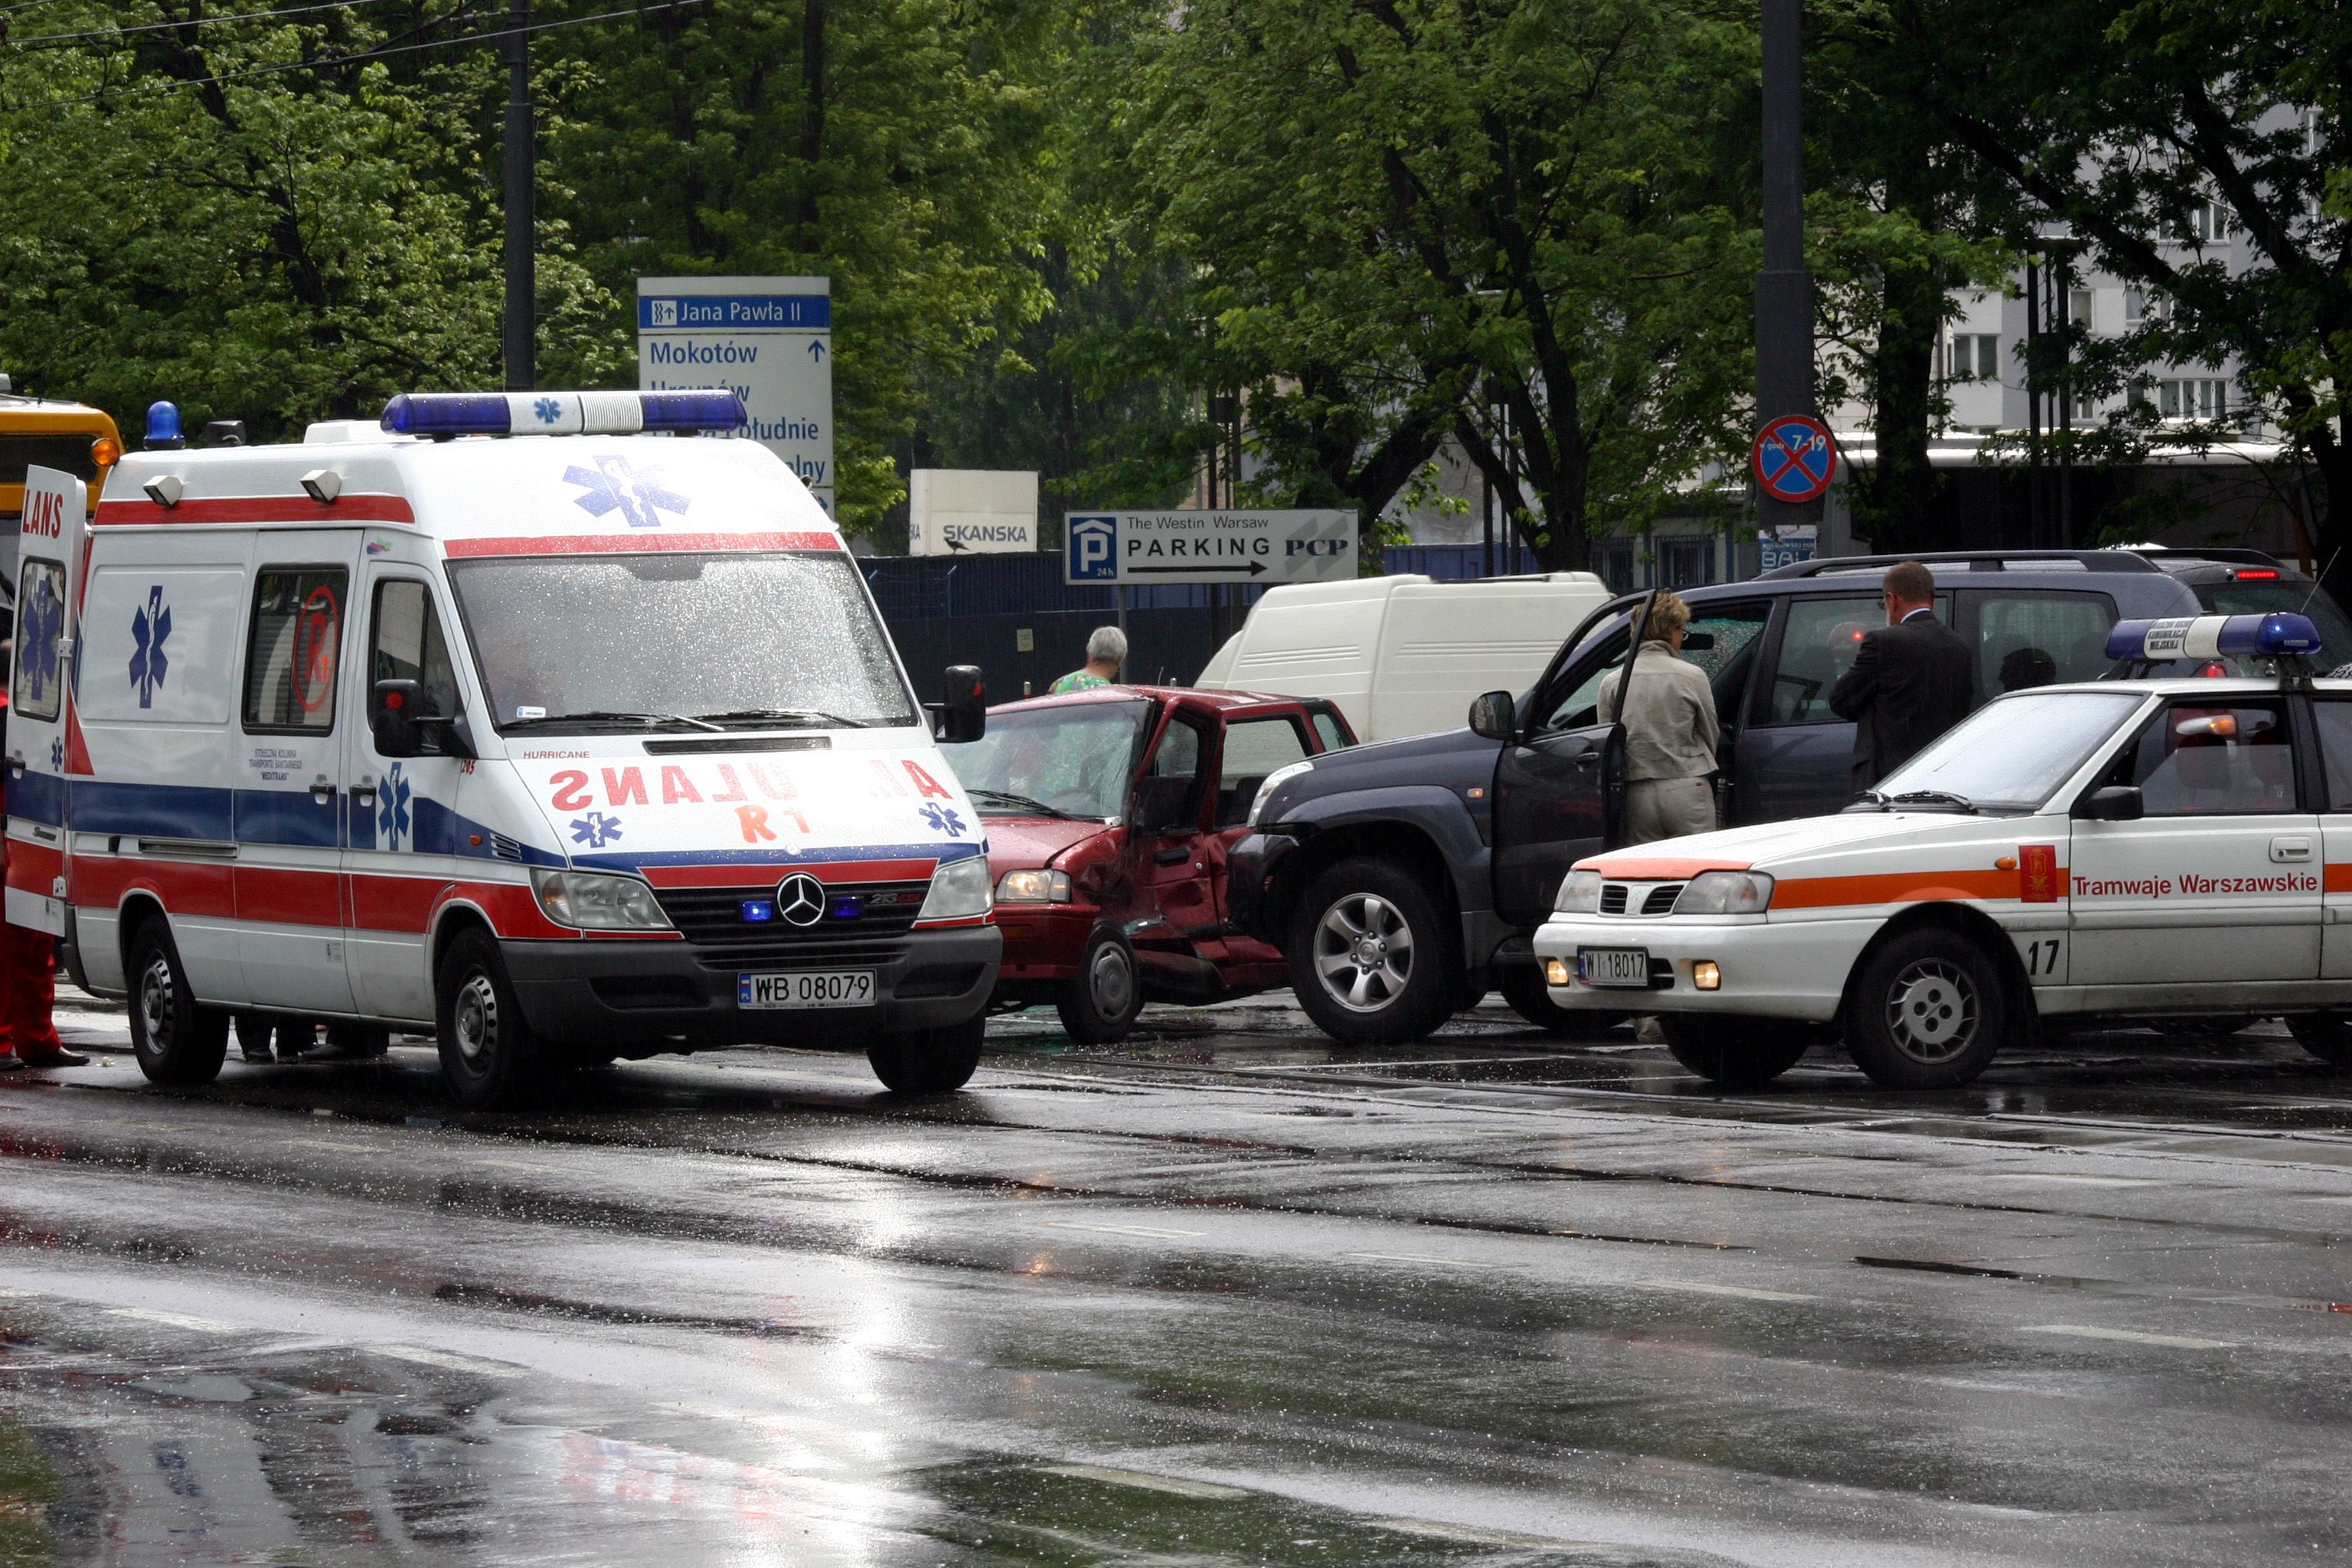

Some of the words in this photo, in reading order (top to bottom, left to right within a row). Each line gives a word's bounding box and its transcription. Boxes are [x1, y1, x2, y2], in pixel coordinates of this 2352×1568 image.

[681, 303, 722, 321] Jana
[730, 301, 783, 321] Pawła
[791, 303, 800, 321] II
[651, 341, 757, 364] Mokotów
[727, 416, 818, 439] ołudnie
[23, 488, 63, 539] LANS
[1127, 517, 1152, 530] The
[1158, 515, 1205, 529] Westin
[1213, 515, 1269, 528] Warsaw
[943, 524, 1027, 542] SKANSKA
[1128, 537, 1270, 557] PARKING
[1285, 539, 1348, 556] PCP
[2072, 876, 2171, 898] Tramwaje
[2179, 872, 2318, 894] Warszawskie
[1586, 953, 1600, 977] WI
[1609, 953, 1644, 978] 18017
[2028, 940, 2060, 975] 17
[756, 977, 789, 1002] WB
[799, 975, 870, 1001] 08079
